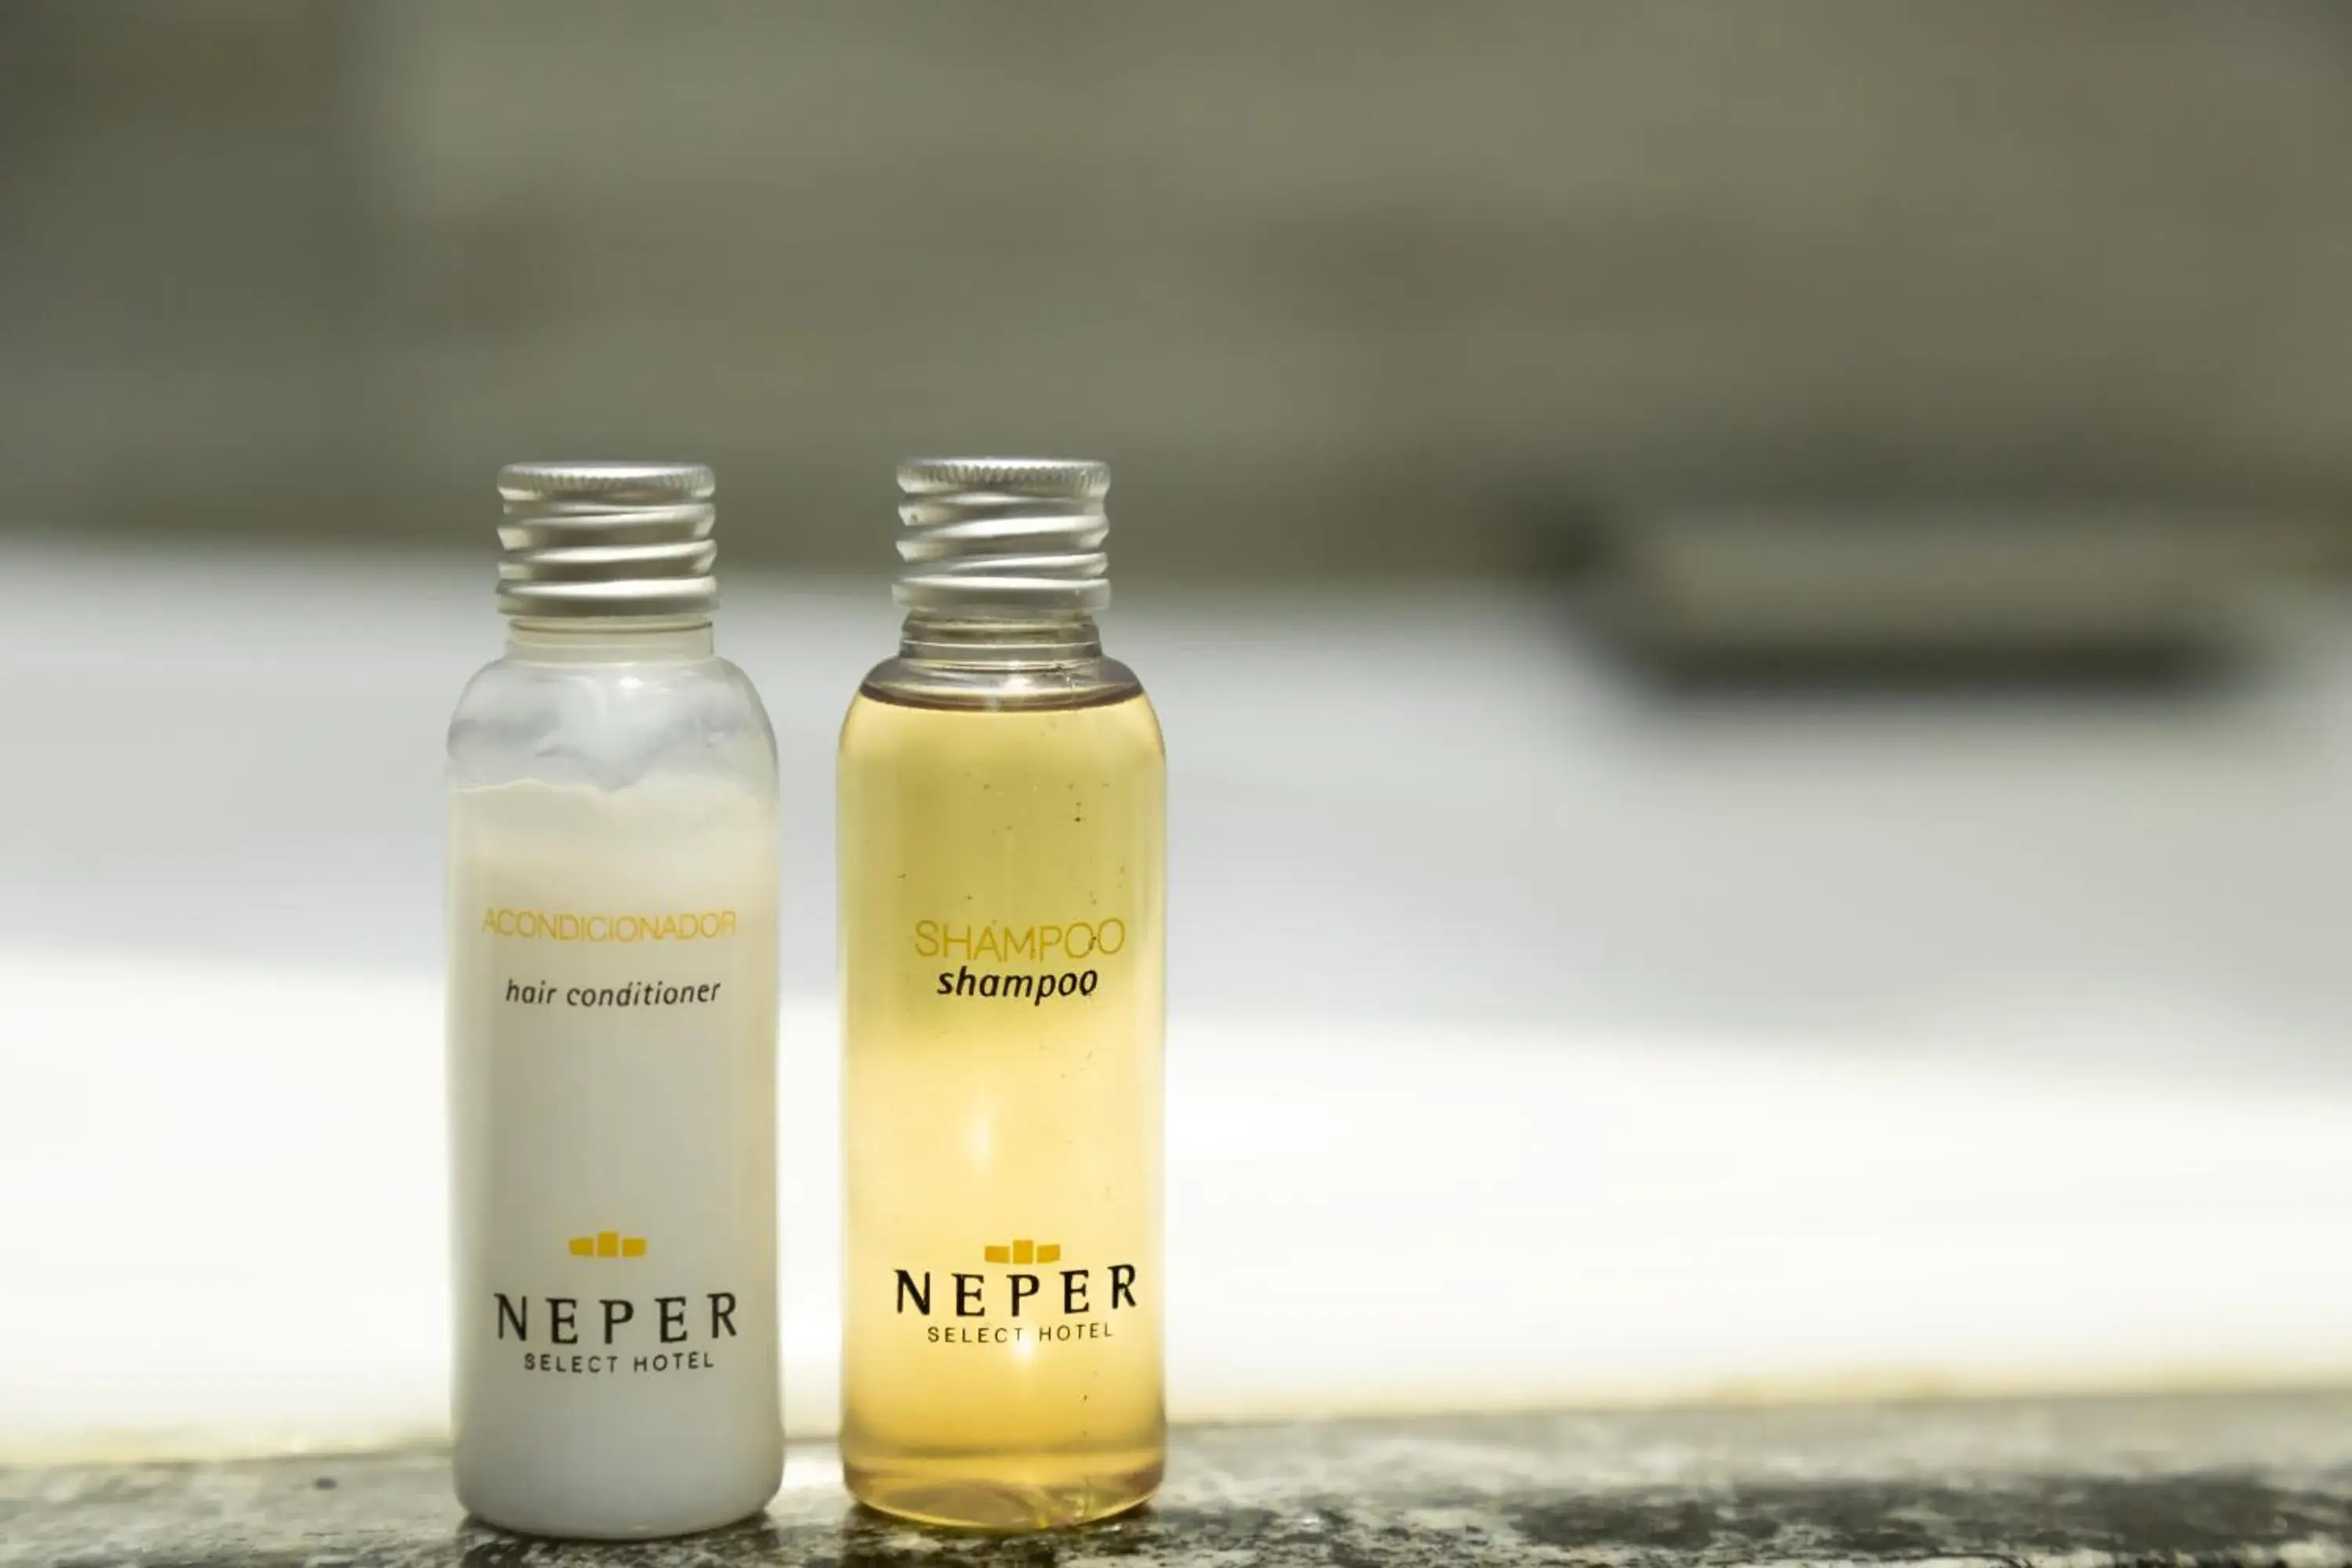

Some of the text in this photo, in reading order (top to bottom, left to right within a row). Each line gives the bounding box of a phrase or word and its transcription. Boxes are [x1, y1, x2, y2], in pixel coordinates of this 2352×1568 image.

[481, 906, 737, 942] ACONDICIONADOR
[914, 917, 1126, 962] SHAMPOO
[506, 978, 721, 1007] hair conditioner
[936, 965, 1098, 1007] shampoo
[892, 1264, 1137, 1318] NEPER
[493, 1292, 738, 1345] NEPER
[927, 1321, 1114, 1344] SELECT HOTEL
[524, 1351, 714, 1374] SELECT HOTEL
